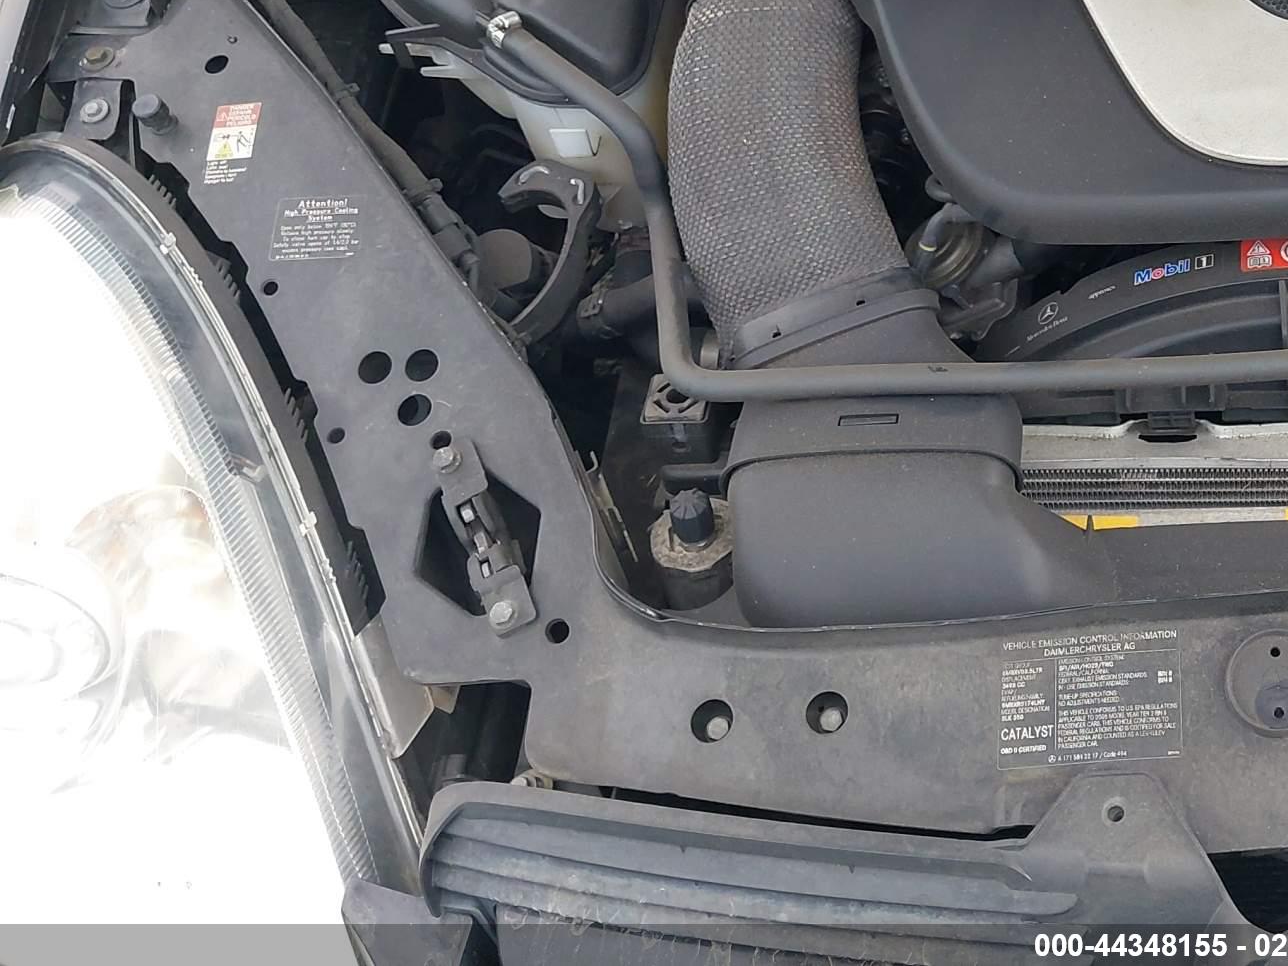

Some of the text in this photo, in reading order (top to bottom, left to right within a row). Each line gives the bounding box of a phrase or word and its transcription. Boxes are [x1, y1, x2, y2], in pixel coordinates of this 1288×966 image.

[298, 198, 348, 209] Attention!
[284, 207, 359, 217] High Pressure Cooling
[1133, 258, 1191, 286] Mobil
[1003, 630, 1177, 651] VEHICLE EMISSION CONTROL INFORMATION
[1044, 642, 1135, 657] DAIMLERCHRYSLER AG
[1001, 725, 1054, 741] CATALYST
[1018, 745, 1047, 754] CERTIFIED
